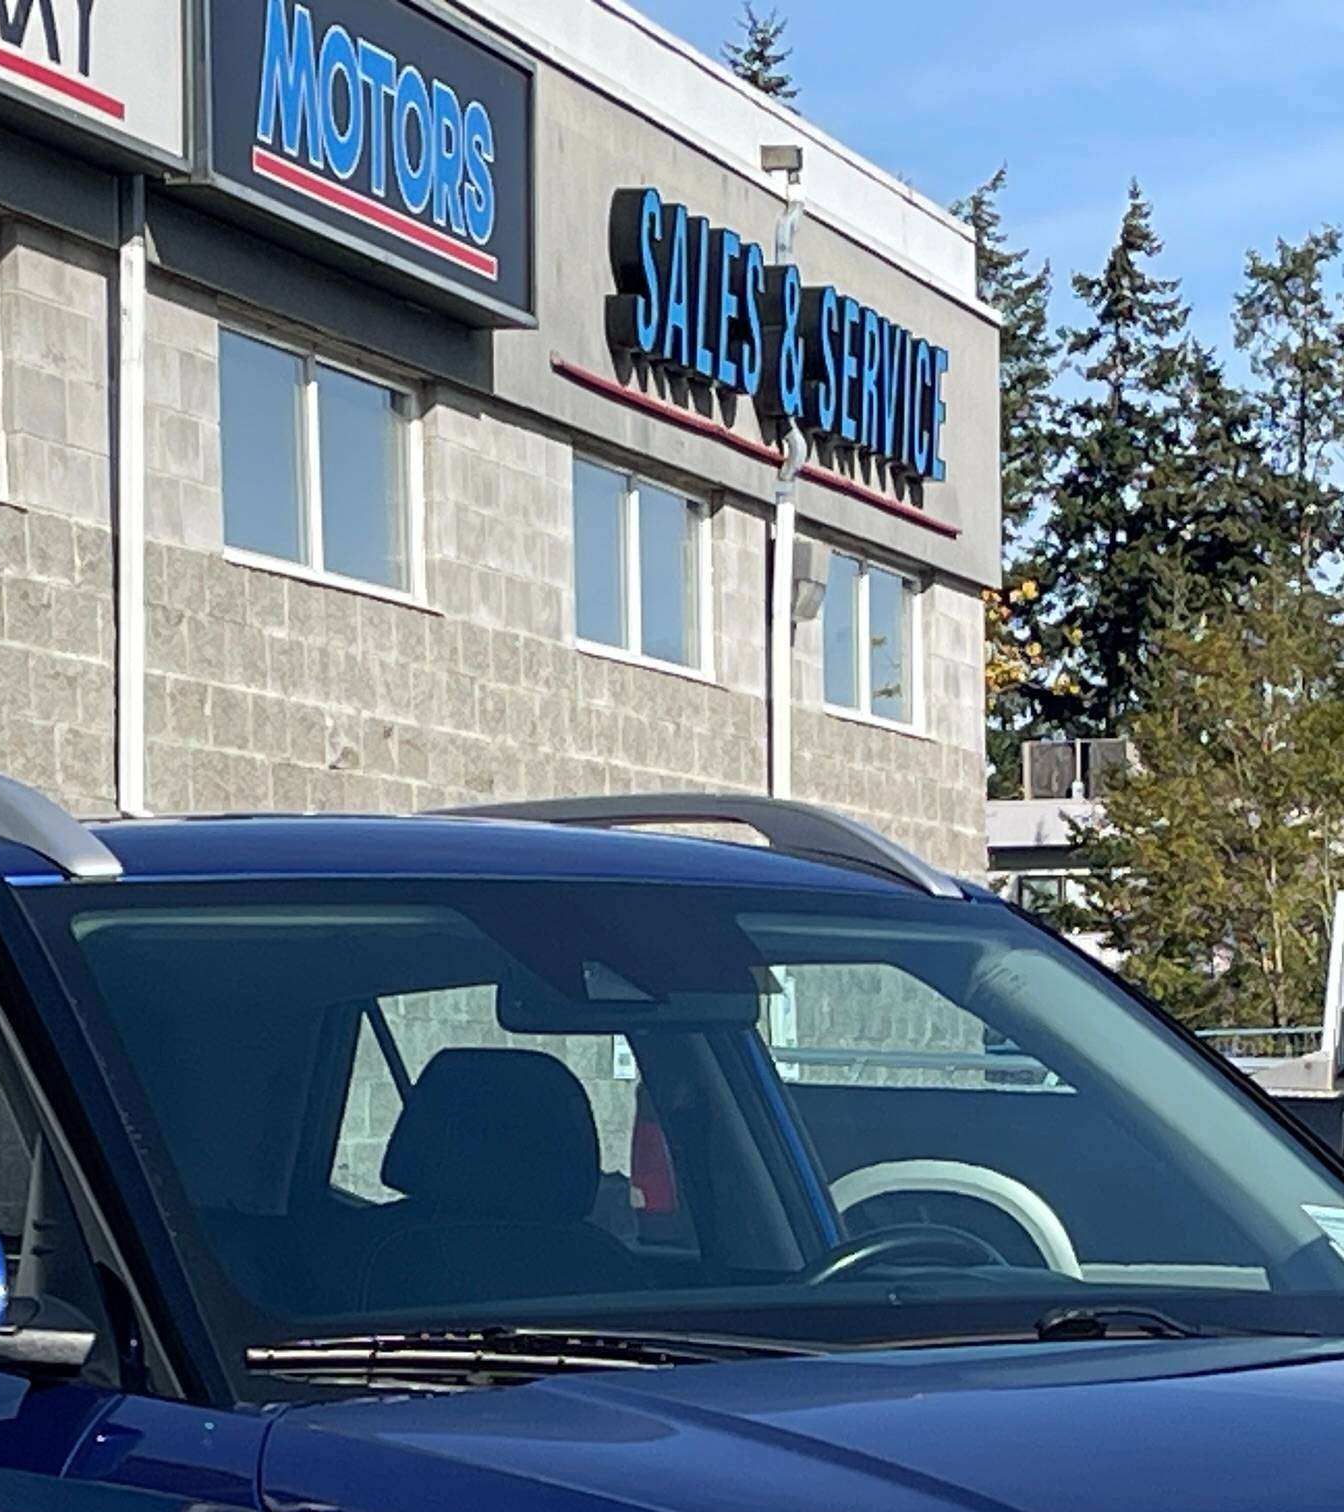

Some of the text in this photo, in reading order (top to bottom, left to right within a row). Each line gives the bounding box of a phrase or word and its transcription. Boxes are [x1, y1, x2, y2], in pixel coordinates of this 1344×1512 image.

[258, 0, 497, 246] MOTORS
[631, 187, 949, 481] SALES & SERVICE
